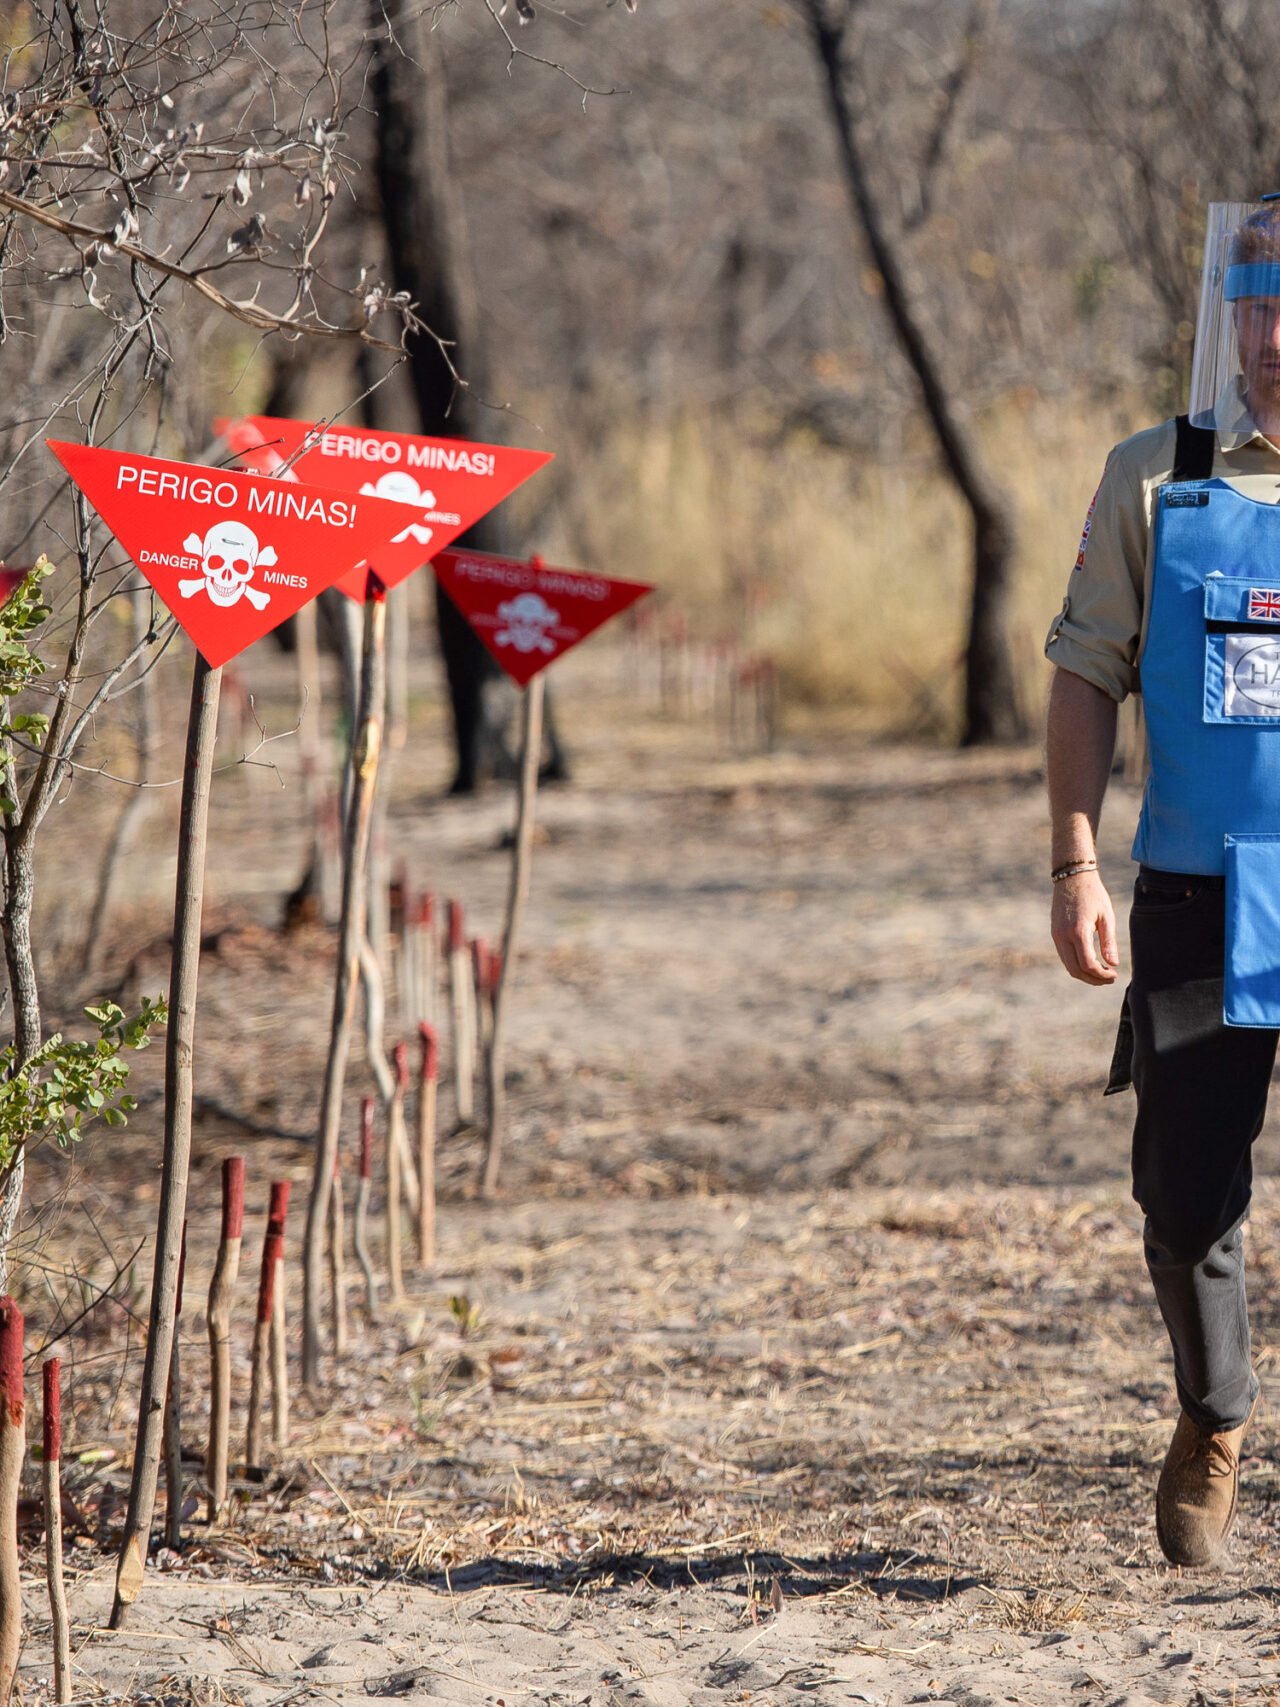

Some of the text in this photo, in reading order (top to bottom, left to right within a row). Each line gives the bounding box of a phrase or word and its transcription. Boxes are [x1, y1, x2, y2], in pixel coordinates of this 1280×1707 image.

[304, 431, 496, 477] PERIGO MINAS!
[116, 465, 357, 528] PERIGO MINAS!
[139, 550, 308, 589] DANGER MINES
